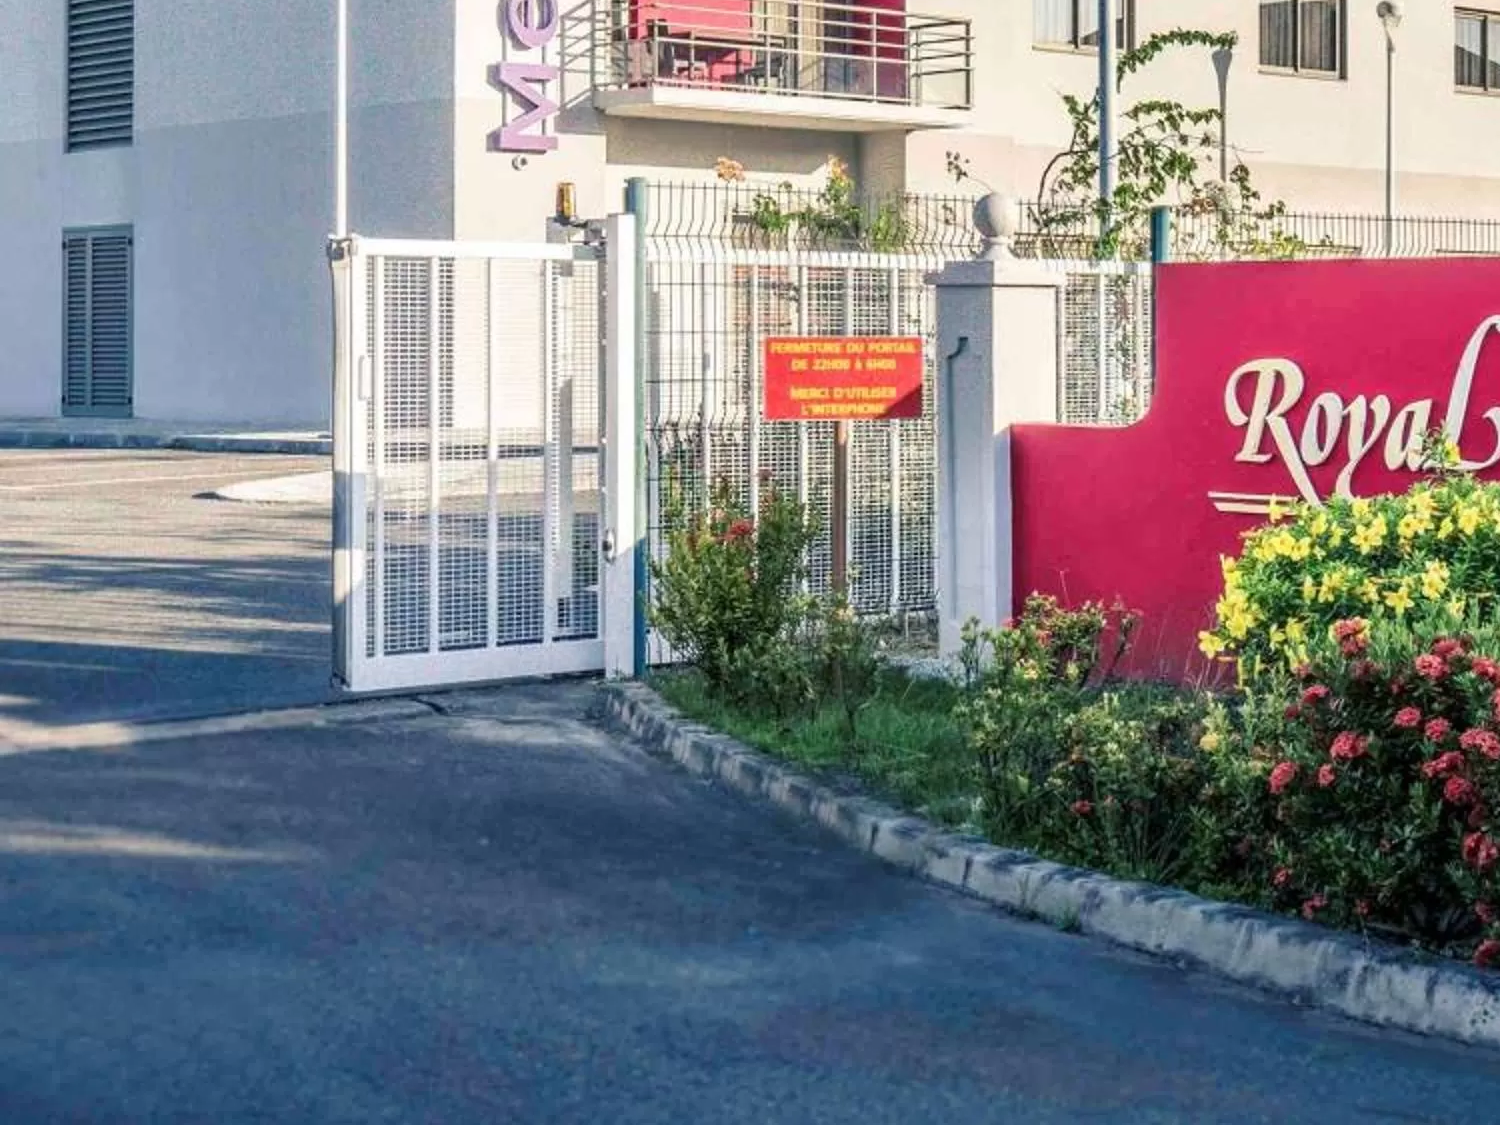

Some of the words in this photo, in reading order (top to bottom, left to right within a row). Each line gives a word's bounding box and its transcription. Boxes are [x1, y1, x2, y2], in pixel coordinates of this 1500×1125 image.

[770, 342, 840, 353] FERMETURE
[846, 341, 865, 353] DU
[867, 342, 917, 353] PORTAIL
[791, 358, 808, 370] DE
[790, 387, 829, 399] MERCI
